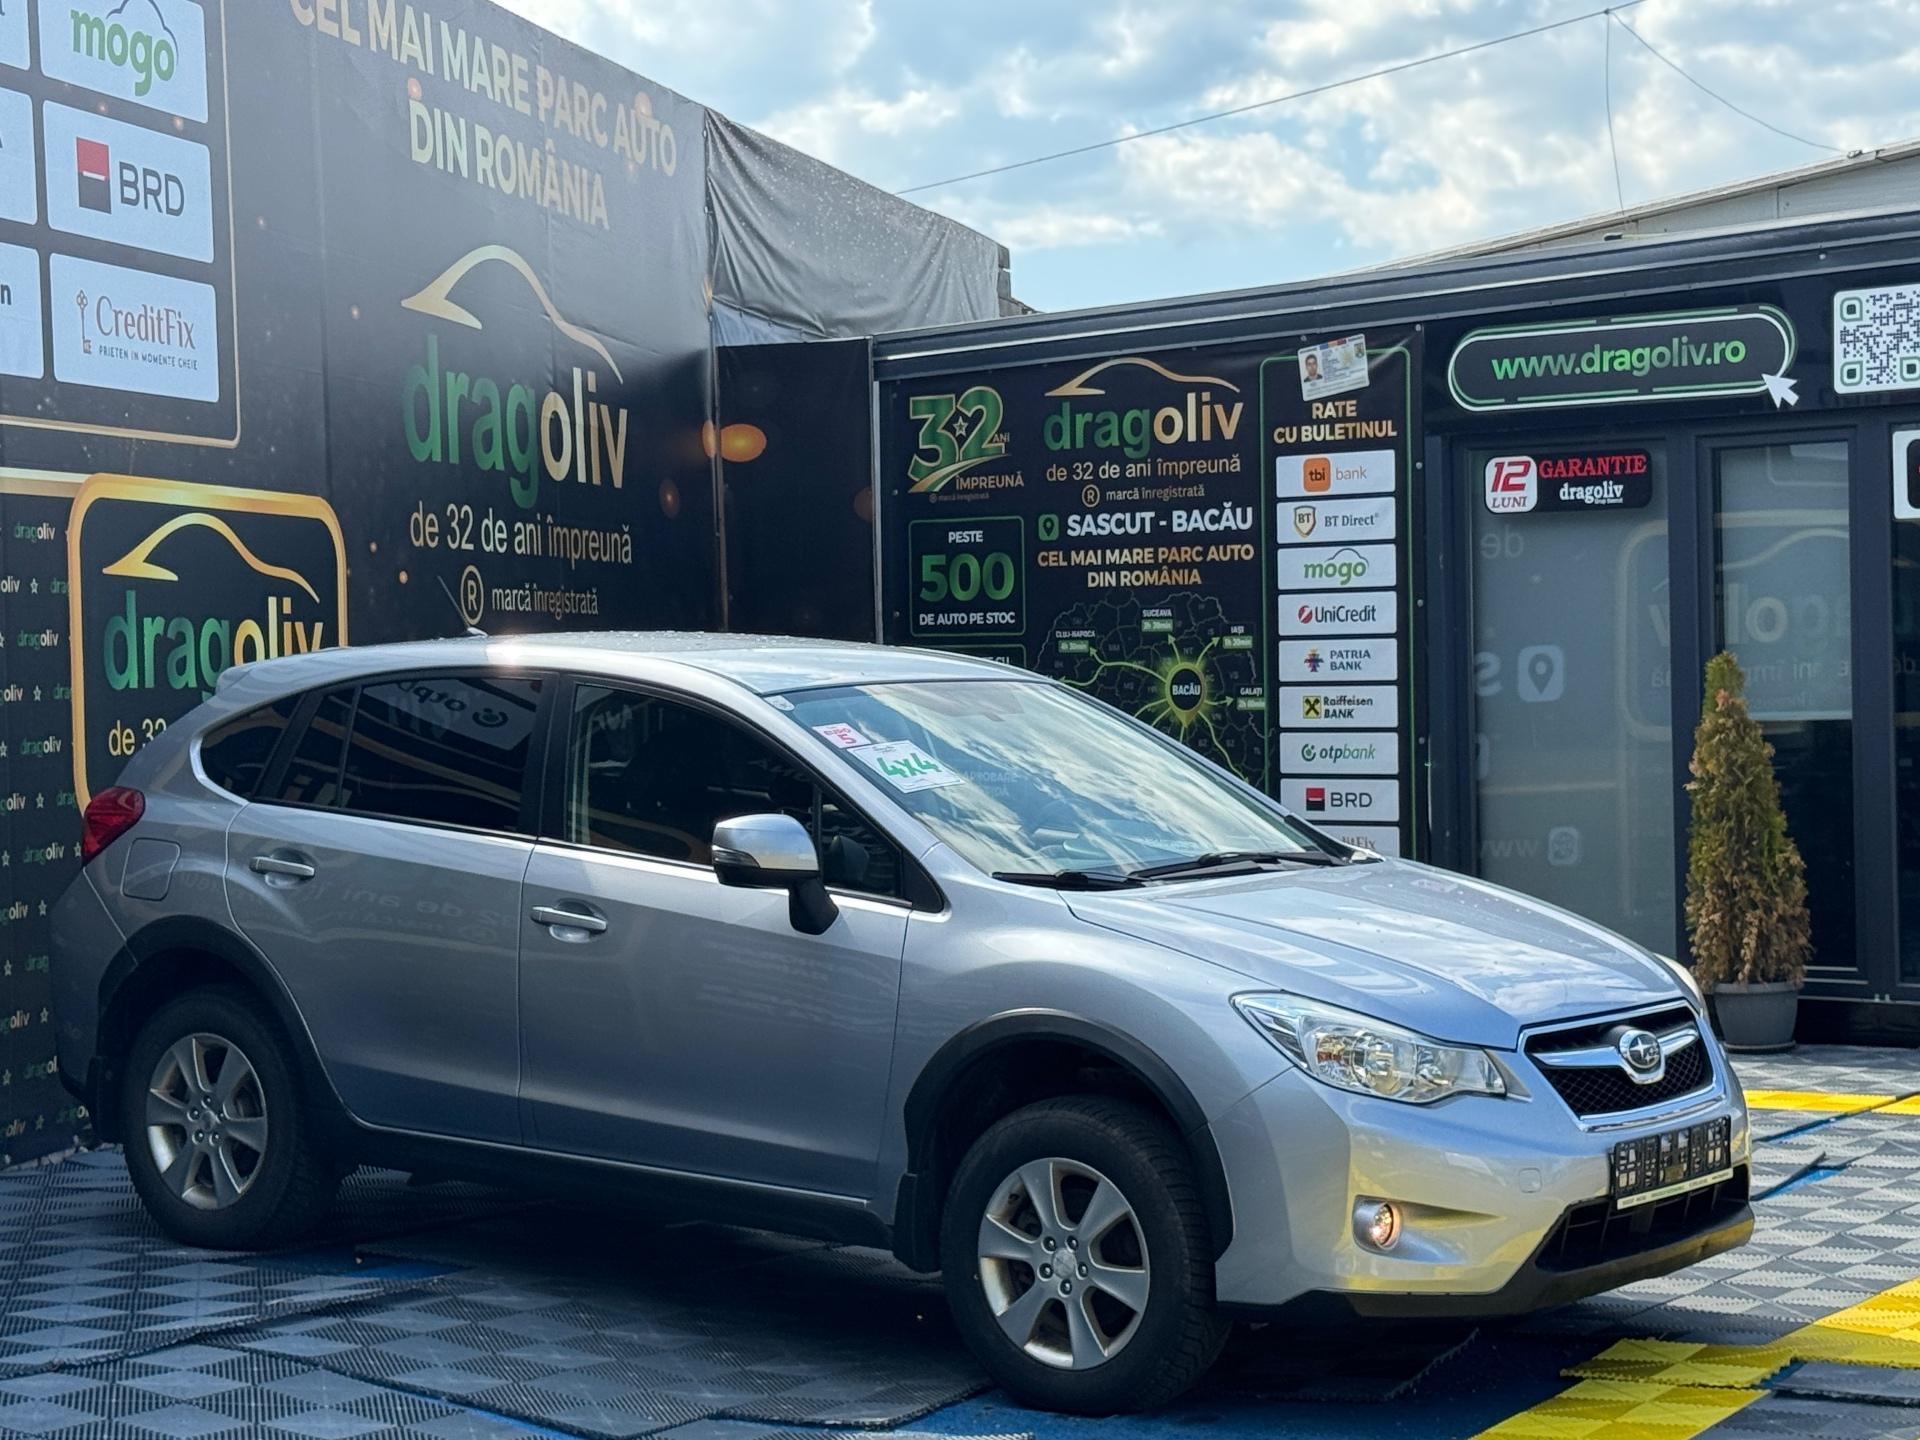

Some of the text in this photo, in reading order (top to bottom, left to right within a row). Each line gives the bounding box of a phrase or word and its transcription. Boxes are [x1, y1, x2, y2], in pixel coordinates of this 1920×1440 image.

[71, 9, 175, 96] mogo
[367, 0, 434, 75] MAI
[440, 20, 531, 116] MARE
[536, 64, 608, 148] PARC
[613, 102, 677, 177] AUTO
[409, 99, 609, 229] DIN ROMÂNIA
[119, 162, 184, 216] BRD
[96, 295, 196, 350] CreditFix
[1491, 336, 1746, 381] www.dragoliv.ro
[1311, 400, 1357, 419] RATE
[404, 334, 628, 510] dragoliv
[1044, 392, 1244, 459] dragoliv
[1274, 420, 1397, 443] CU BULETINUL
[907, 386, 1003, 482] 32
[1046, 453, 1241, 482] de 32 de ani împreună
[1309, 465, 1367, 482] tbi bank
[1491, 454, 1647, 492] 12 GARANTIE
[956, 471, 1025, 491] ÎMPREUNĂ
[1106, 487, 1139, 501] marcă
[1491, 497, 1527, 509] LUNI
[1559, 481, 1624, 504] dragoliv
[1067, 511, 1155, 537] SASCUT
[1172, 501, 1253, 533] BACĂU
[1298, 513, 1311, 524] BT
[1324, 516, 1339, 527] BT
[15, 521, 55, 543] dragoliv
[410, 500, 632, 570] de 32 de ani împreună
[948, 530, 984, 544] PESTE
[1037, 544, 1254, 567] CEL MAI MARE PARC AUTO
[920, 552, 1015, 602] 500
[1087, 566, 1202, 588] DIN ROMÂNIA
[1304, 561, 1367, 585] mogo
[0, 576, 20, 593] oliv
[492, 583, 532, 612] marcă
[920, 612, 1015, 626] DE AUTO PE STOC
[1315, 605, 1376, 623] UniCredit
[17, 629, 58, 650] dragoliv
[104, 590, 323, 703] dragoliv
[1330, 649, 1371, 660] PATRIA
[1330, 661, 1362, 671] BANK
[0, 684, 23, 705] oliv
[1172, 682, 1201, 696] BACĂU
[1324, 696, 1373, 707] Raiffeisen
[1324, 709, 1355, 719] BANK
[21, 736, 61, 758] dragoliv
[108, 719, 136, 757] de
[1319, 744, 1376, 763] otpbank
[1330, 792, 1373, 808] BRD
[24, 842, 64, 866] dragoliv
